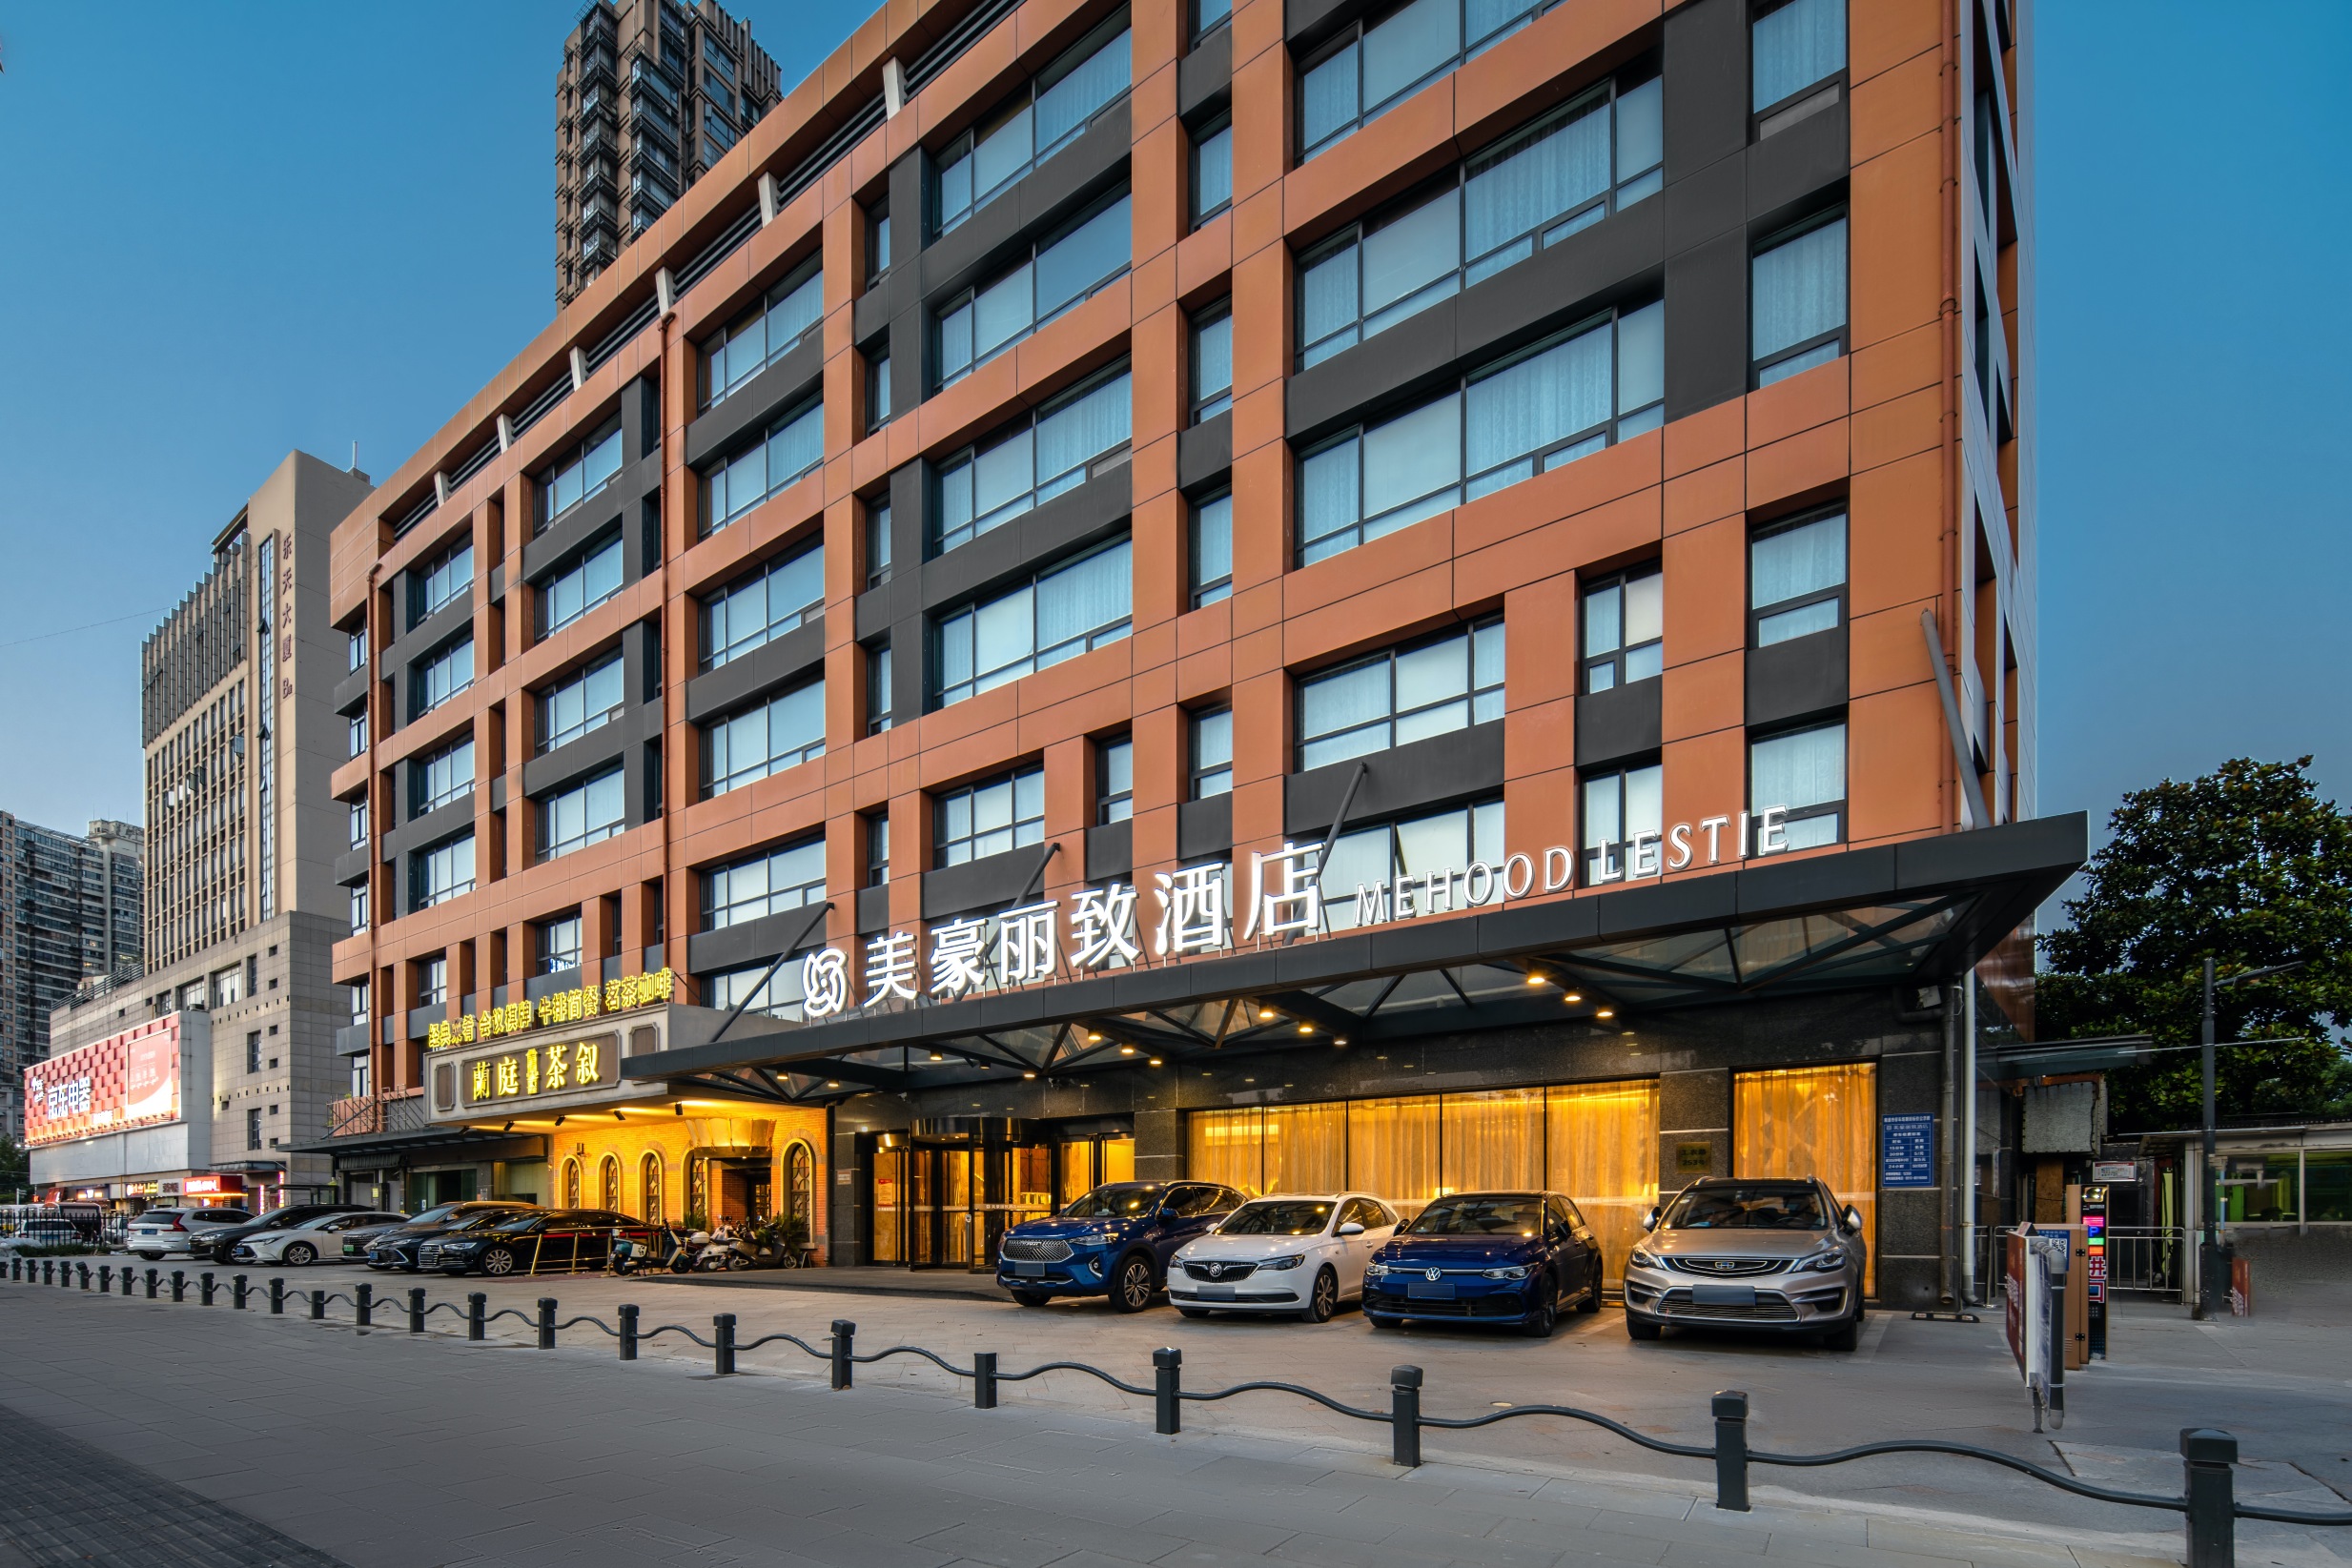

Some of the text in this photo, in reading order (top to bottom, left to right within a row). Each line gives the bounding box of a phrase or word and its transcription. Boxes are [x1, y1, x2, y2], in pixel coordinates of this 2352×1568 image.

[1355, 805, 1790, 927] MEHOOD LESTIE
[863, 841, 1324, 1008] 美豪丽致酒店
[479, 1000, 533, 1037] 会议棋牌
[539, 986, 600, 1025] 牛排简餐
[605, 967, 673, 1010] 茗茶咖啡
[48, 1076, 91, 1120] 京东电器
[473, 1056, 520, 1101] 蘭庭
[545, 1042, 600, 1089] 茶叙
